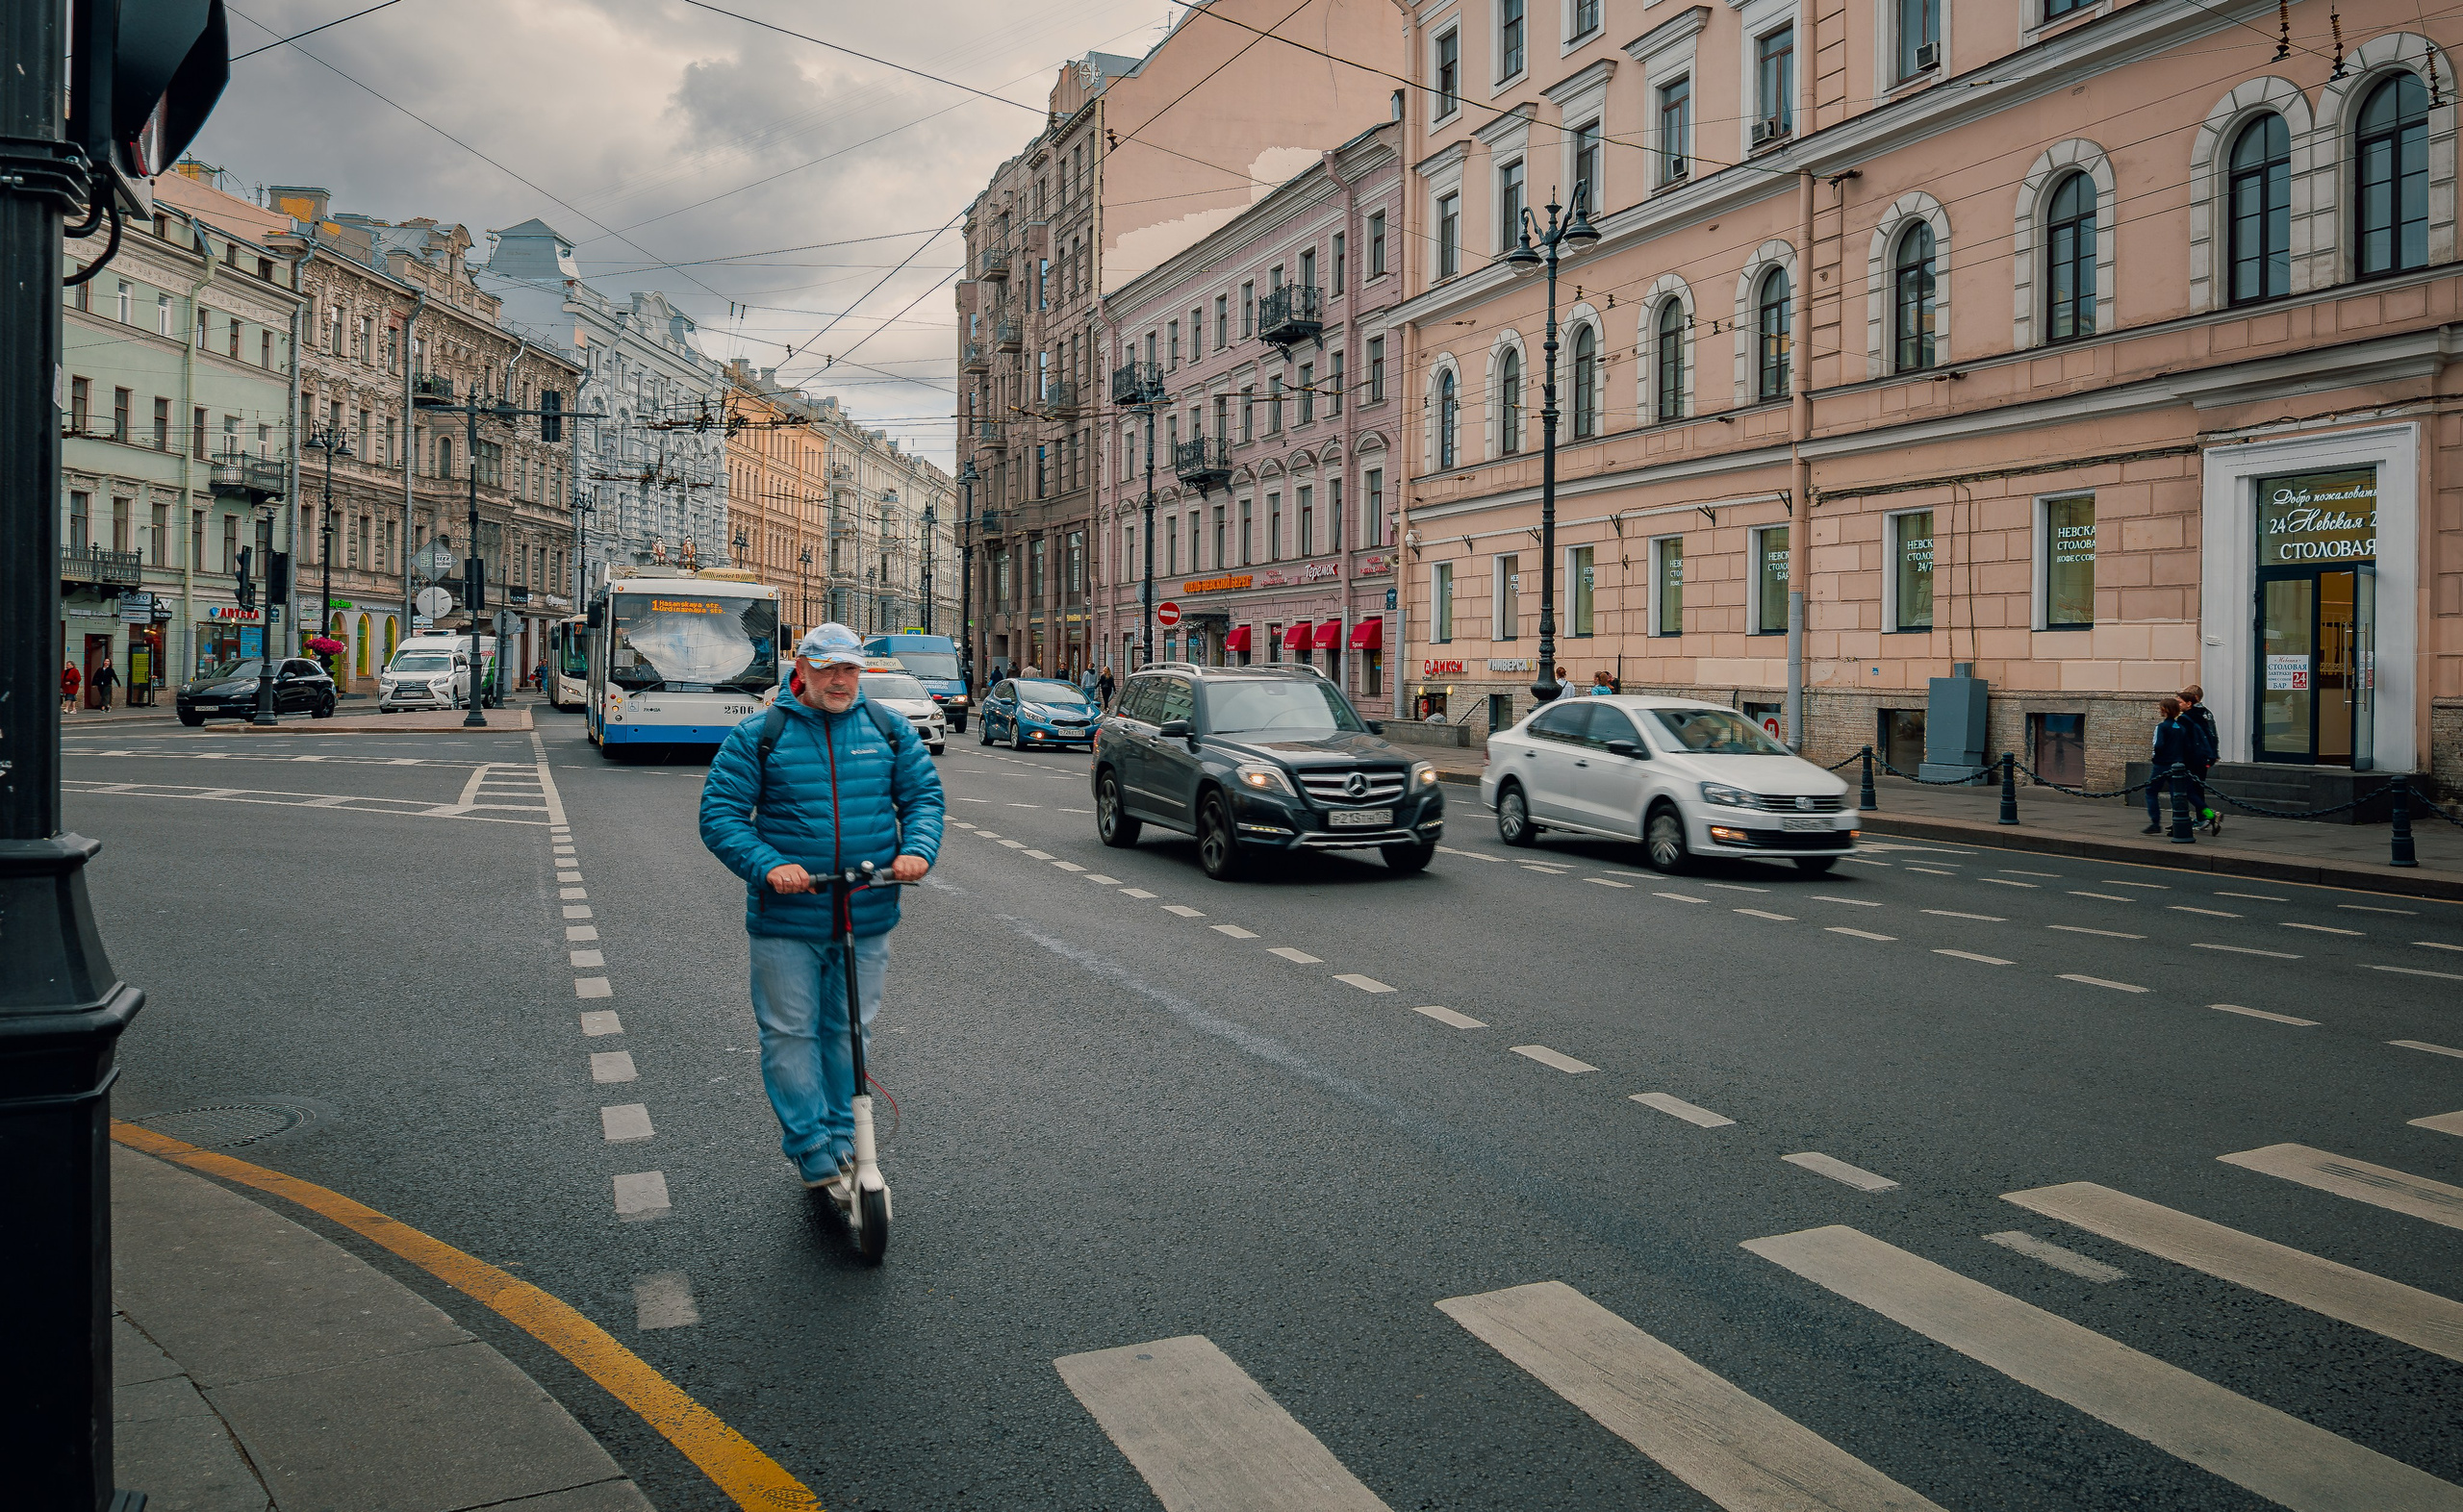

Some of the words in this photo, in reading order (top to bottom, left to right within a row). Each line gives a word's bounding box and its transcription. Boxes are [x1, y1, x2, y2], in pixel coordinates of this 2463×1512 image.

[2273, 489, 2311, 507] Добро
[2313, 485, 2377, 501] пожаловать
[2270, 517, 2286, 534] 24
[2287, 508, 2363, 533] Невская
[2280, 539, 2377, 559] СТОЛОВАЯ
[1305, 563, 1338, 581] Теремок
[651, 599, 658, 611] 1
[220, 607, 260, 618] АПТЕКА
[574, 624, 583, 635] 27
[1433, 660, 1463, 674] ДИКСИ
[2294, 673, 2306, 683] 24
[724, 705, 754, 715] 2506
